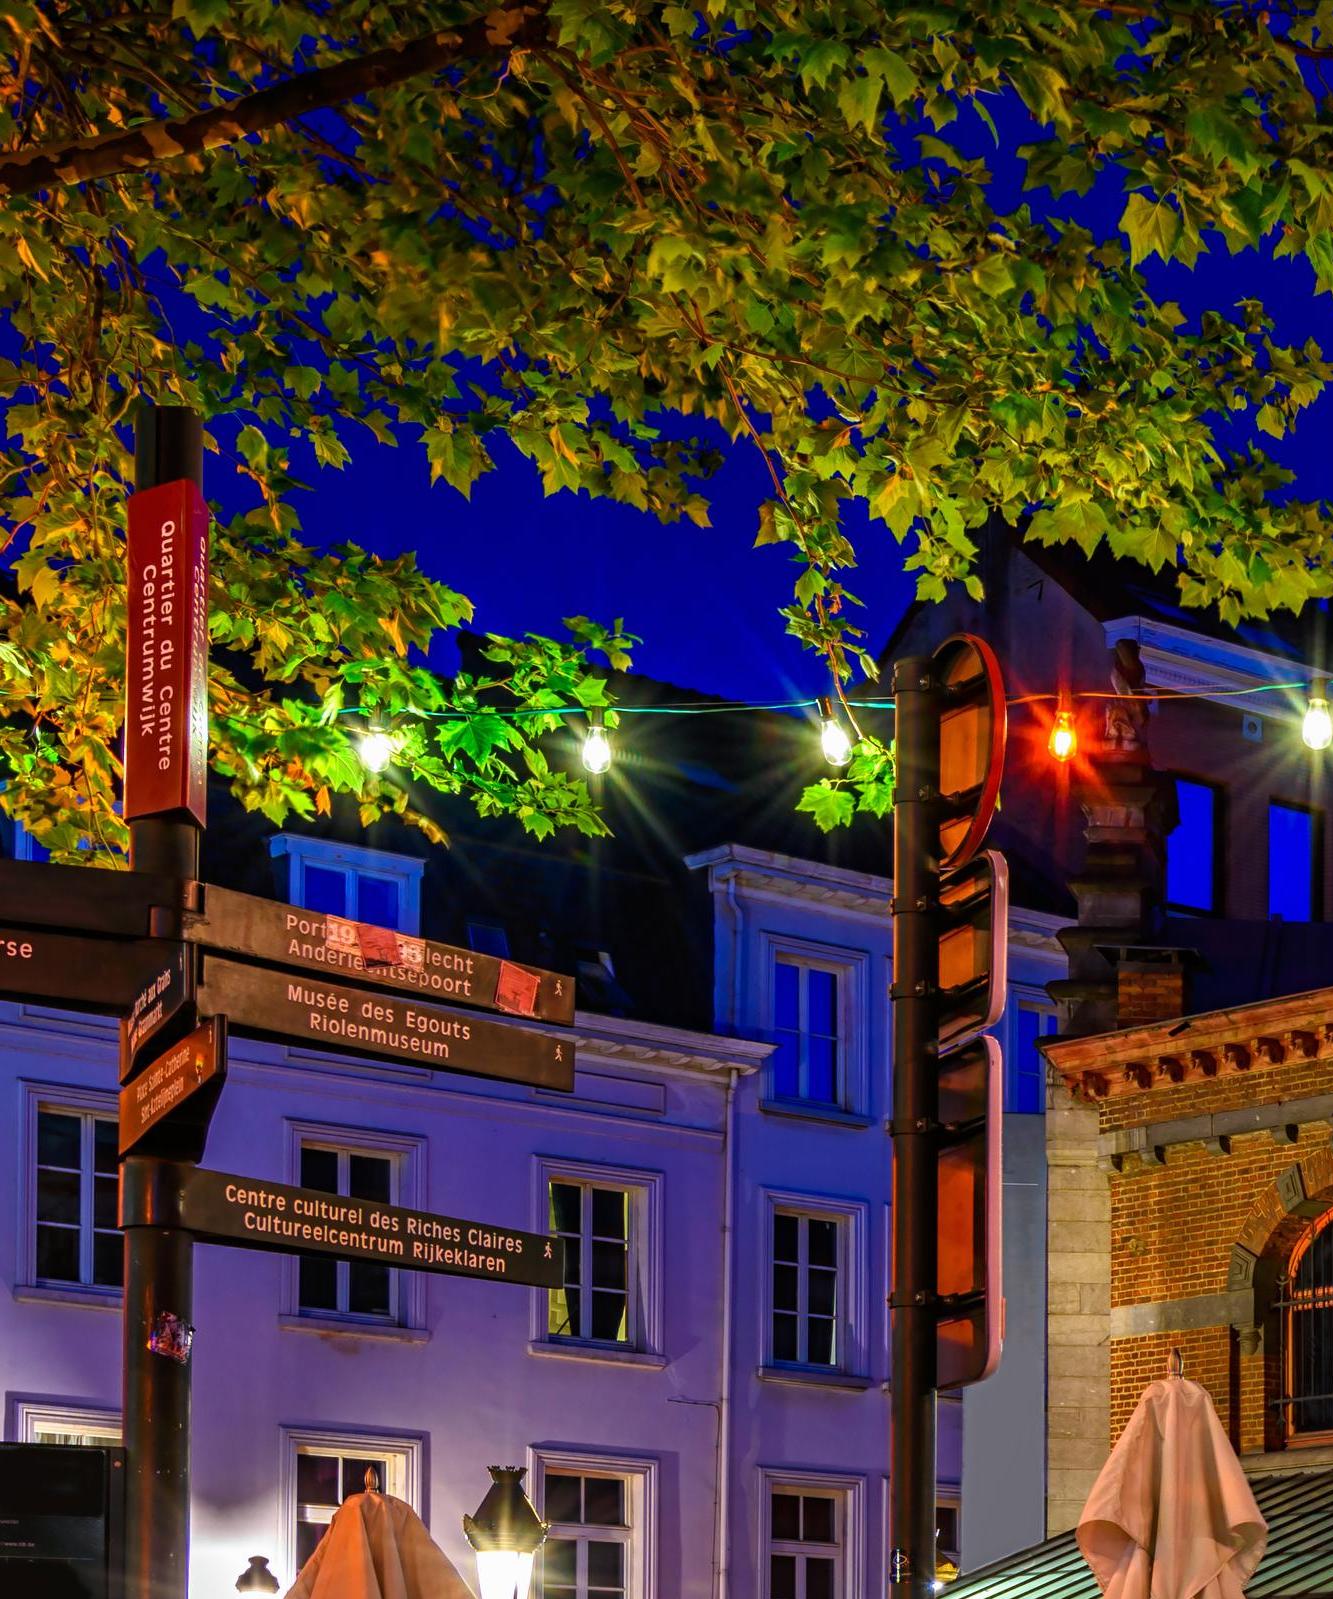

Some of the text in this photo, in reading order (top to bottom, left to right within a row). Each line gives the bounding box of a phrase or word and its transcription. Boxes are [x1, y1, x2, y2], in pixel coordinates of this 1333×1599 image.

[141, 564, 157, 737] Centrumwijk
[158, 520, 176, 771] Quartier du Centre
[286, 914, 329, 940] Port
[288, 984, 472, 1041] Musée des Egouts
[310, 1012, 450, 1059] Riolenmuseum
[225, 1184, 523, 1254] Centre culturel des Riches Claires
[244, 1212, 506, 1273] Cultureelcentrum Rijkeklaren
